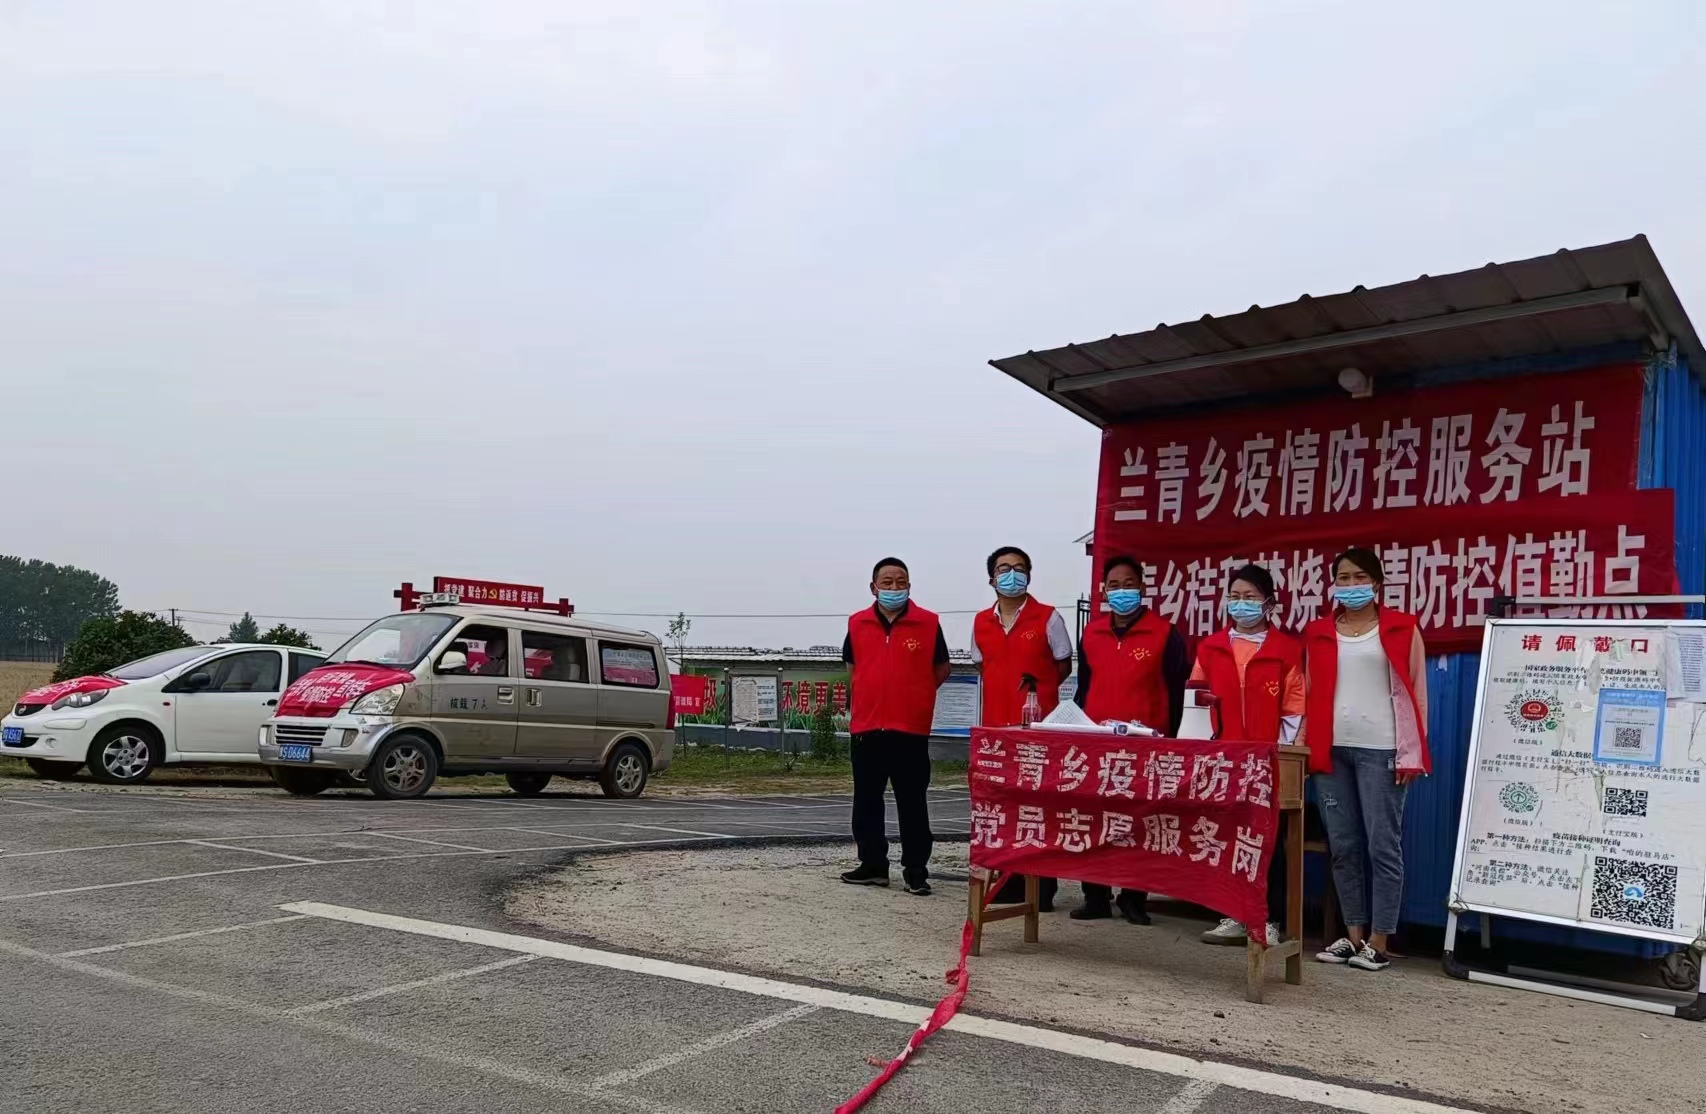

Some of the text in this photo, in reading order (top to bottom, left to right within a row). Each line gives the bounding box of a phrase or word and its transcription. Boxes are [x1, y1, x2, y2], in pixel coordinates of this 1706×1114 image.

[1114, 400, 1597, 524] 兰青乡疫情防控服务站
[976, 737, 1273, 808] 兰青乡疫情防控
[971, 801, 1264, 883] 党员志愿服务岗
